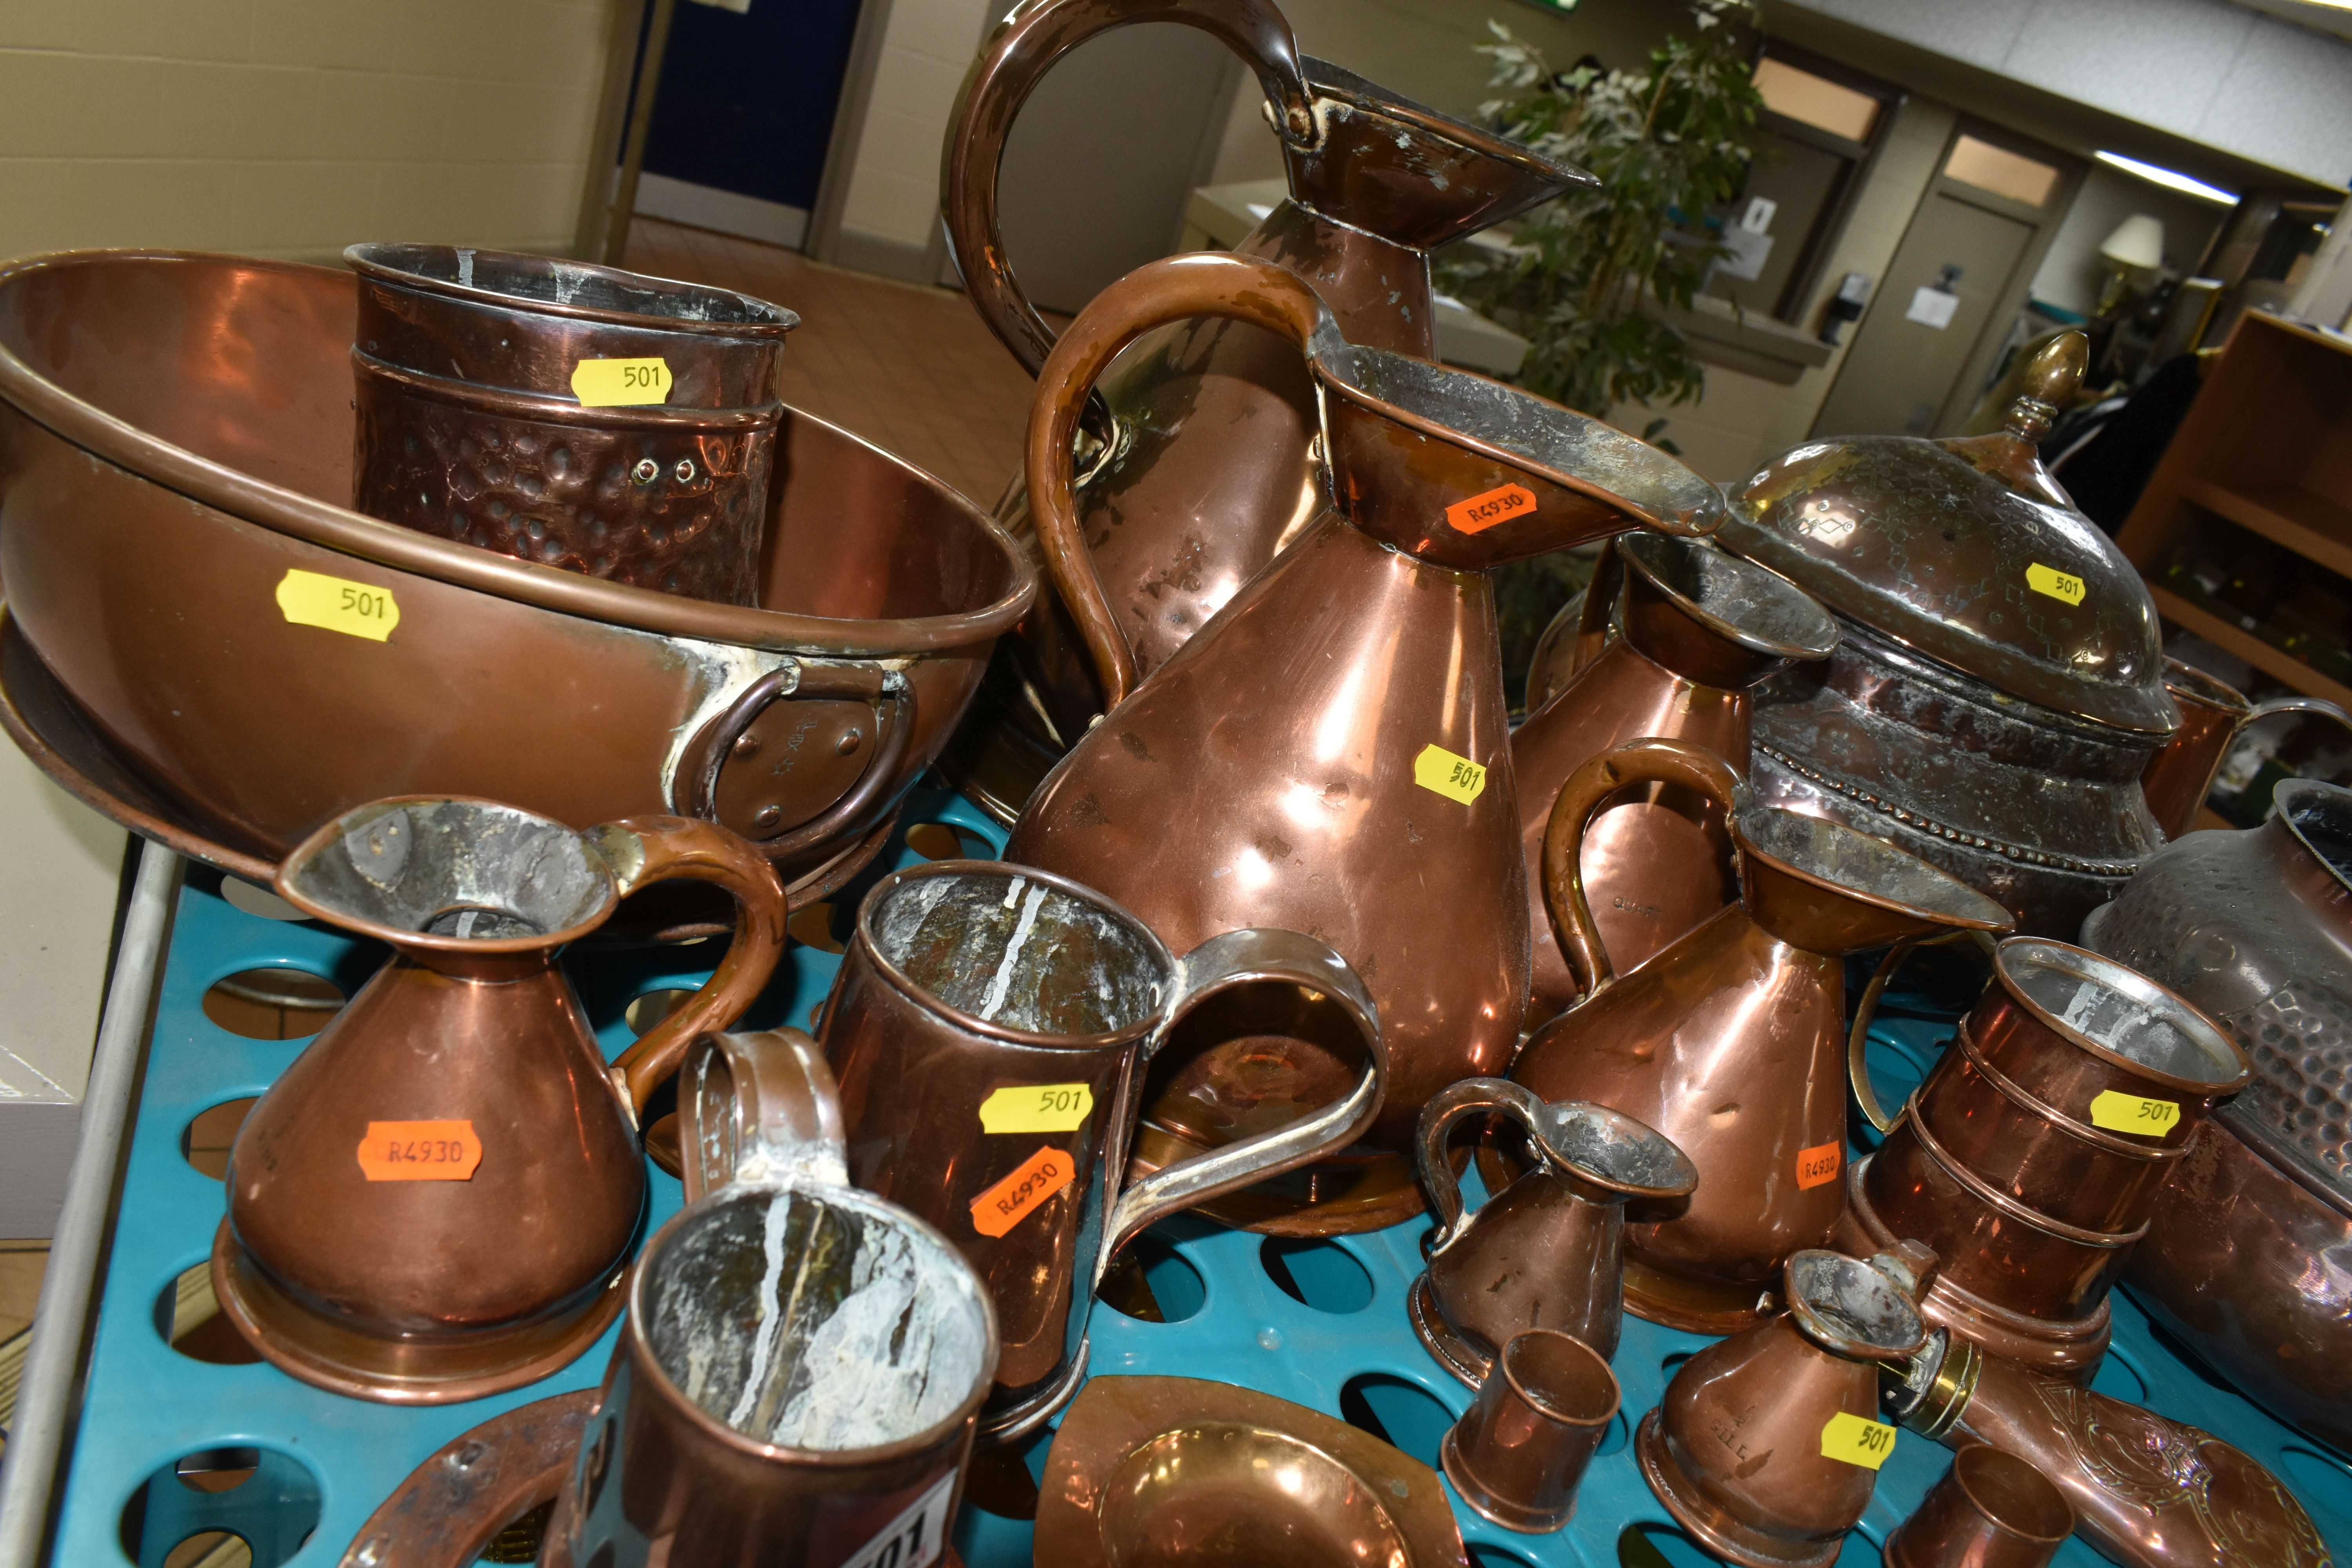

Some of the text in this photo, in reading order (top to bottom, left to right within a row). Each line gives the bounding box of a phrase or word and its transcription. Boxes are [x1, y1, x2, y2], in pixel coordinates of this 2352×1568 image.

[624, 367, 659, 387] 501
[1468, 493, 1523, 523] R4930
[2056, 577, 2078, 595] 501
[341, 588, 385, 619] 501
[1450, 762, 1481, 791] 501
[1039, 1091, 1080, 1113] 501
[2138, 1102, 2173, 1121] 501
[388, 1140, 462, 1163] R4930
[1806, 1156, 1835, 1179] R4930
[996, 1163, 1058, 1216] R4930
[1710, 1419, 1748, 1461] GILL
[1858, 1425, 1890, 1453] 501
[862, 1511, 926, 1568] 01
